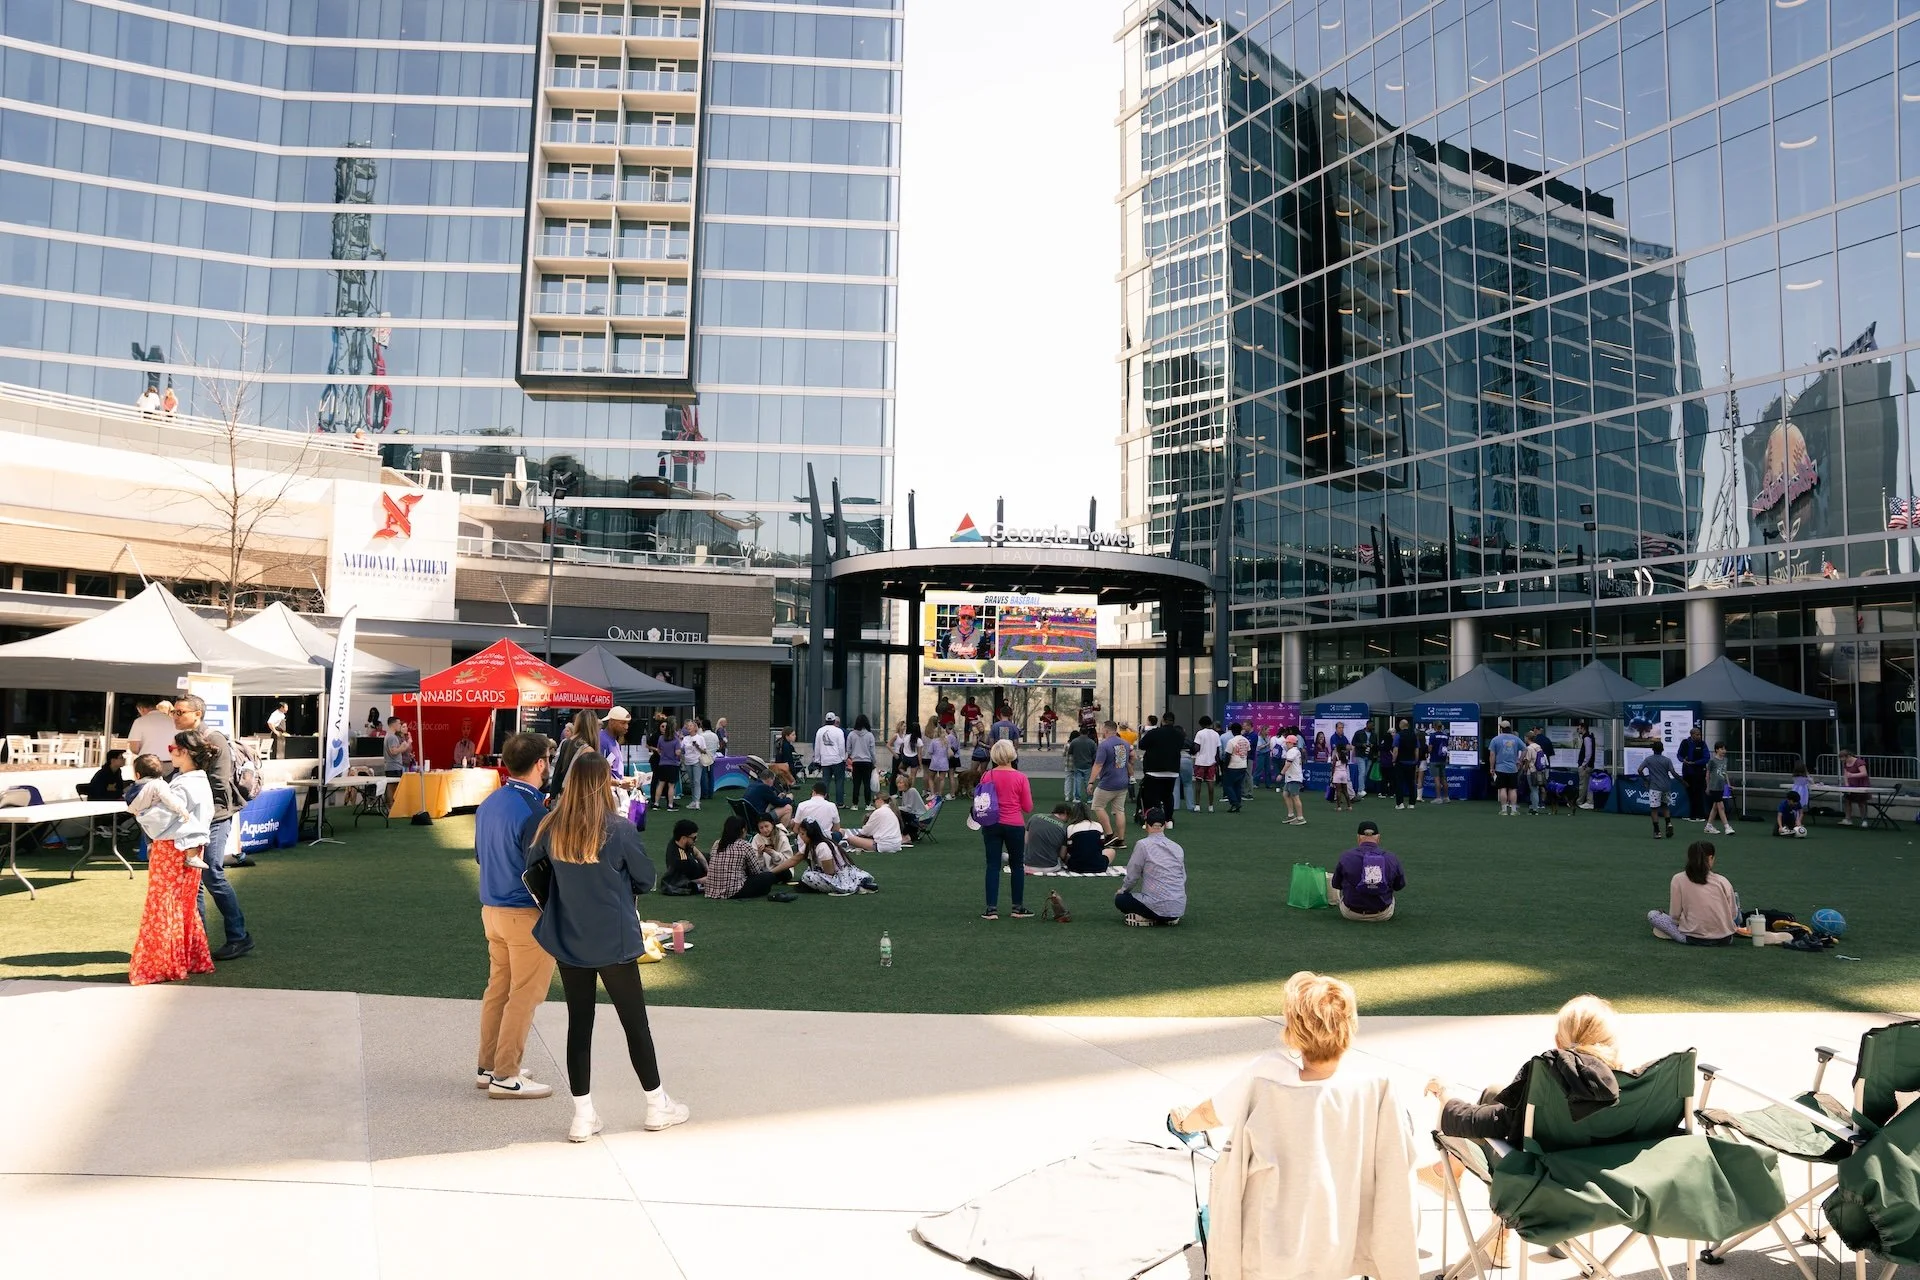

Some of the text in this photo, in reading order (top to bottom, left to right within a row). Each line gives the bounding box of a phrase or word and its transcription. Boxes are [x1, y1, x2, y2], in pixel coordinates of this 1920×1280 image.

[990, 522, 1135, 548] Georgia Power
[344, 552, 448, 575] NATIONAL ANTHEM
[1002, 550, 1085, 562] PAVILION
[984, 595, 1040, 605] BRAVES BASEBALL
[607, 625, 705, 643] OMNI HOTEL
[335, 642, 348, 730] Aquestive
[402, 689, 506, 704] CANNABIS CARDS
[522, 691, 611, 705] MEDICAL MARIJUANA CARDS
[240, 818, 280, 838] Aquestive
